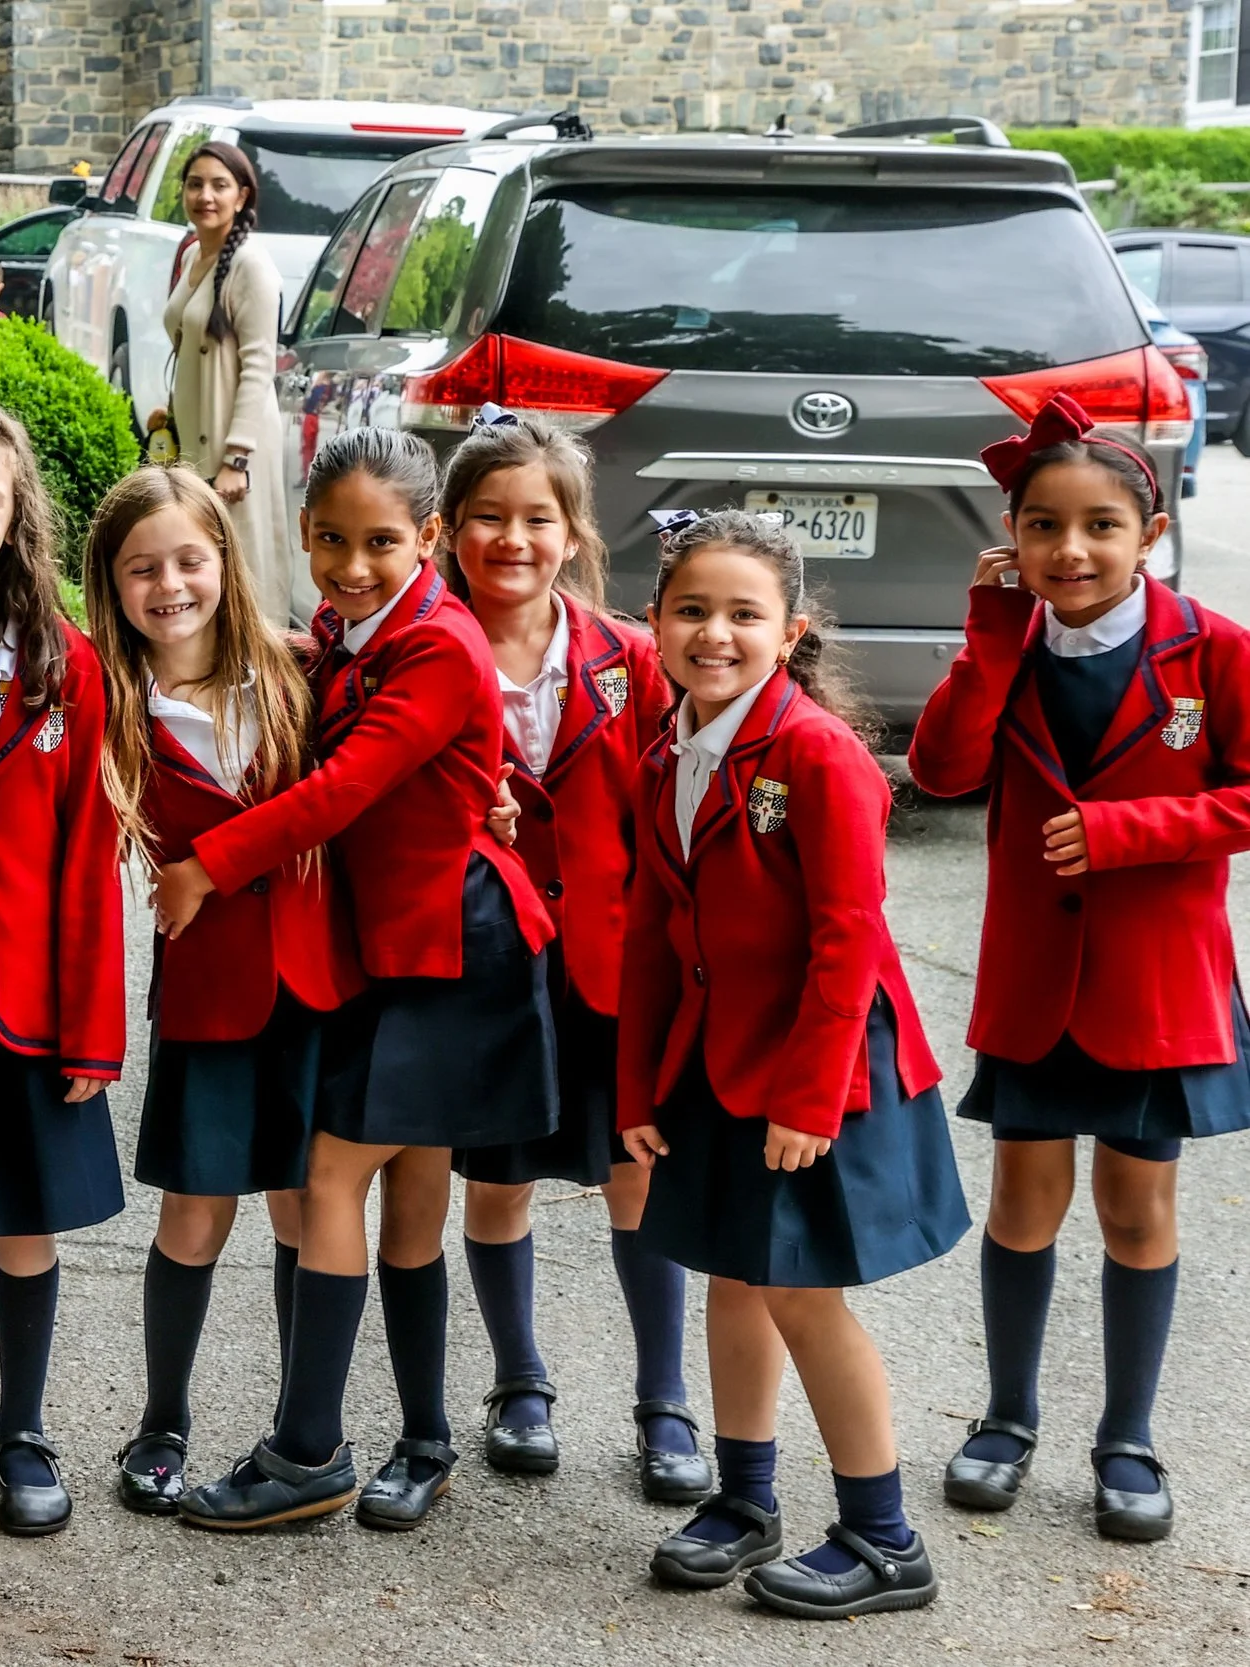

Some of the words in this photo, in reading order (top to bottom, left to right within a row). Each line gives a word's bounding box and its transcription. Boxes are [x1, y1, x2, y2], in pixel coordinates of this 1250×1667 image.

[780, 496, 806, 507] NEW
[811, 497, 843, 508] YORK
[810, 510, 865, 541] 6320
